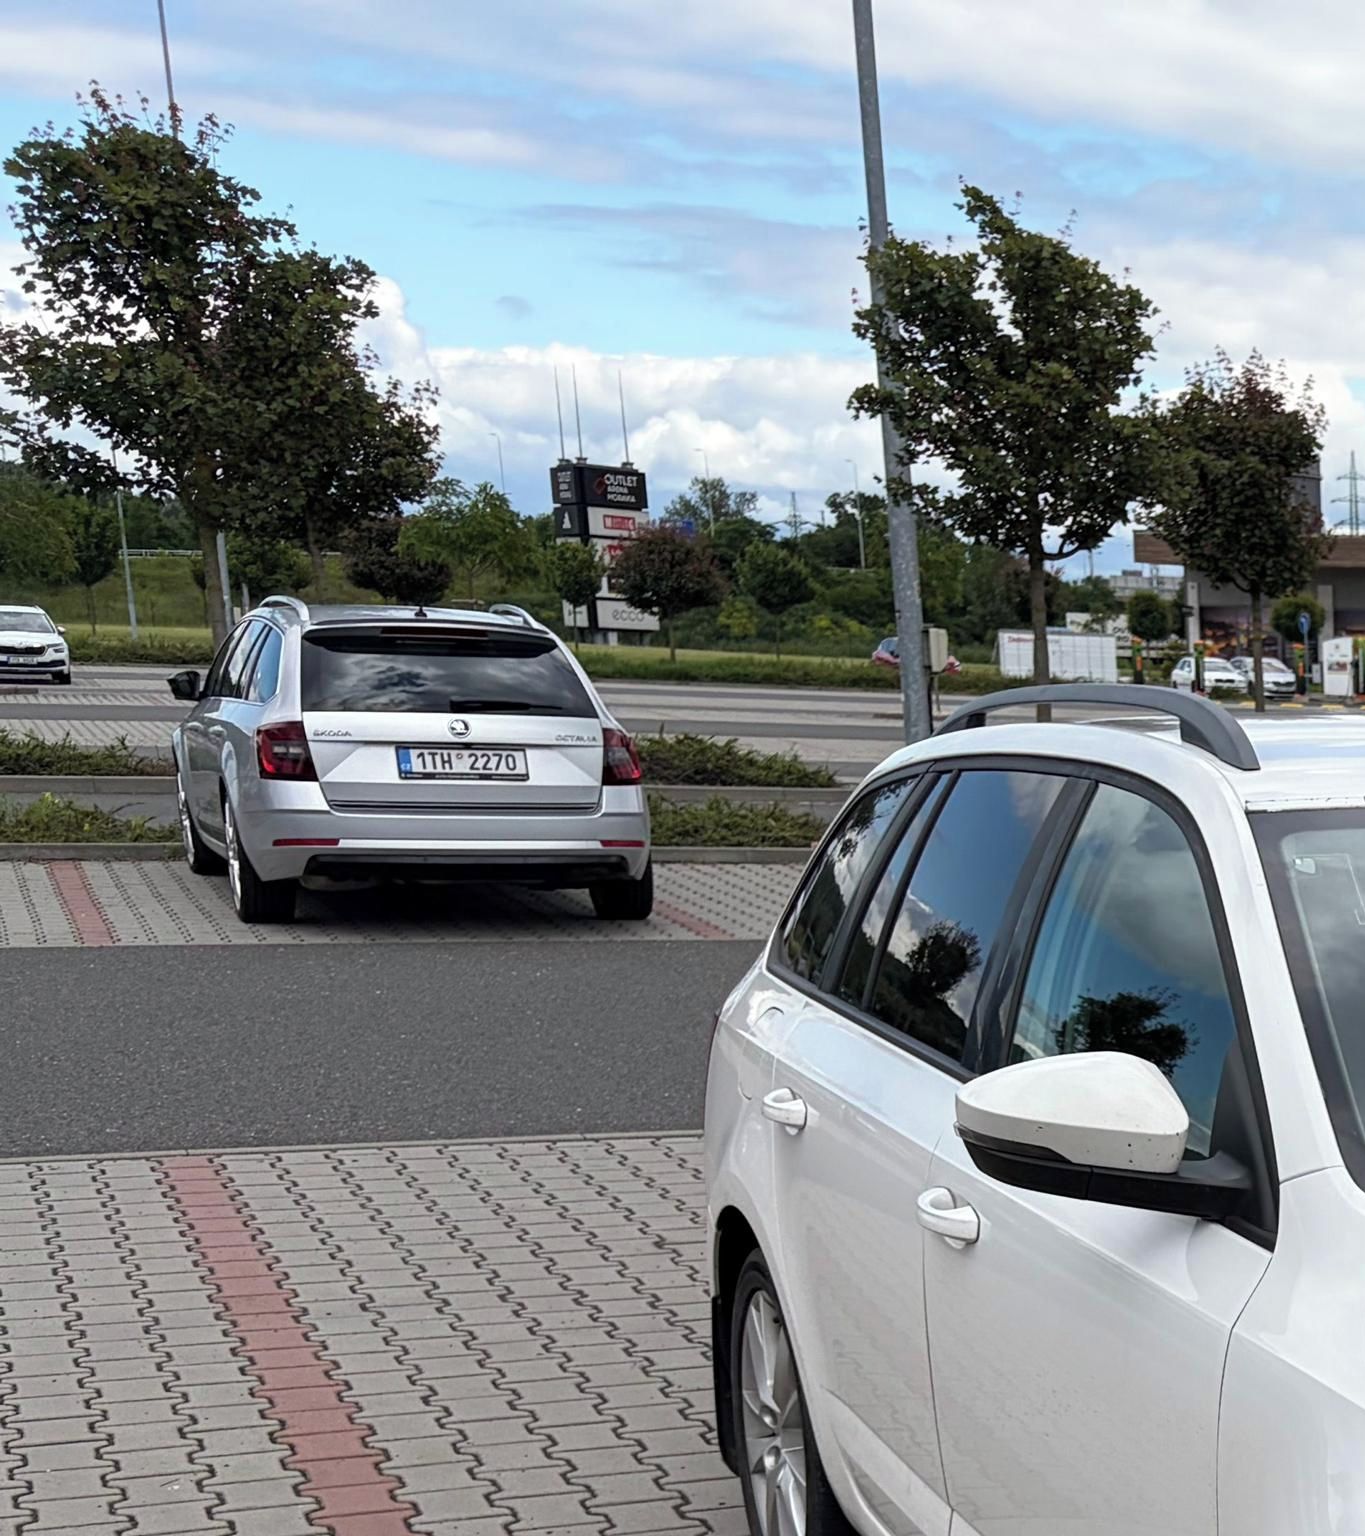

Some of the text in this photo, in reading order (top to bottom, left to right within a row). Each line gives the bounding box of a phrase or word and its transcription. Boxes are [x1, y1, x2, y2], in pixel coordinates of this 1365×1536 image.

[604, 473, 638, 487] OUTLET
[612, 609, 645, 622] ecco
[416, 751, 517, 771] 1TH 2270
